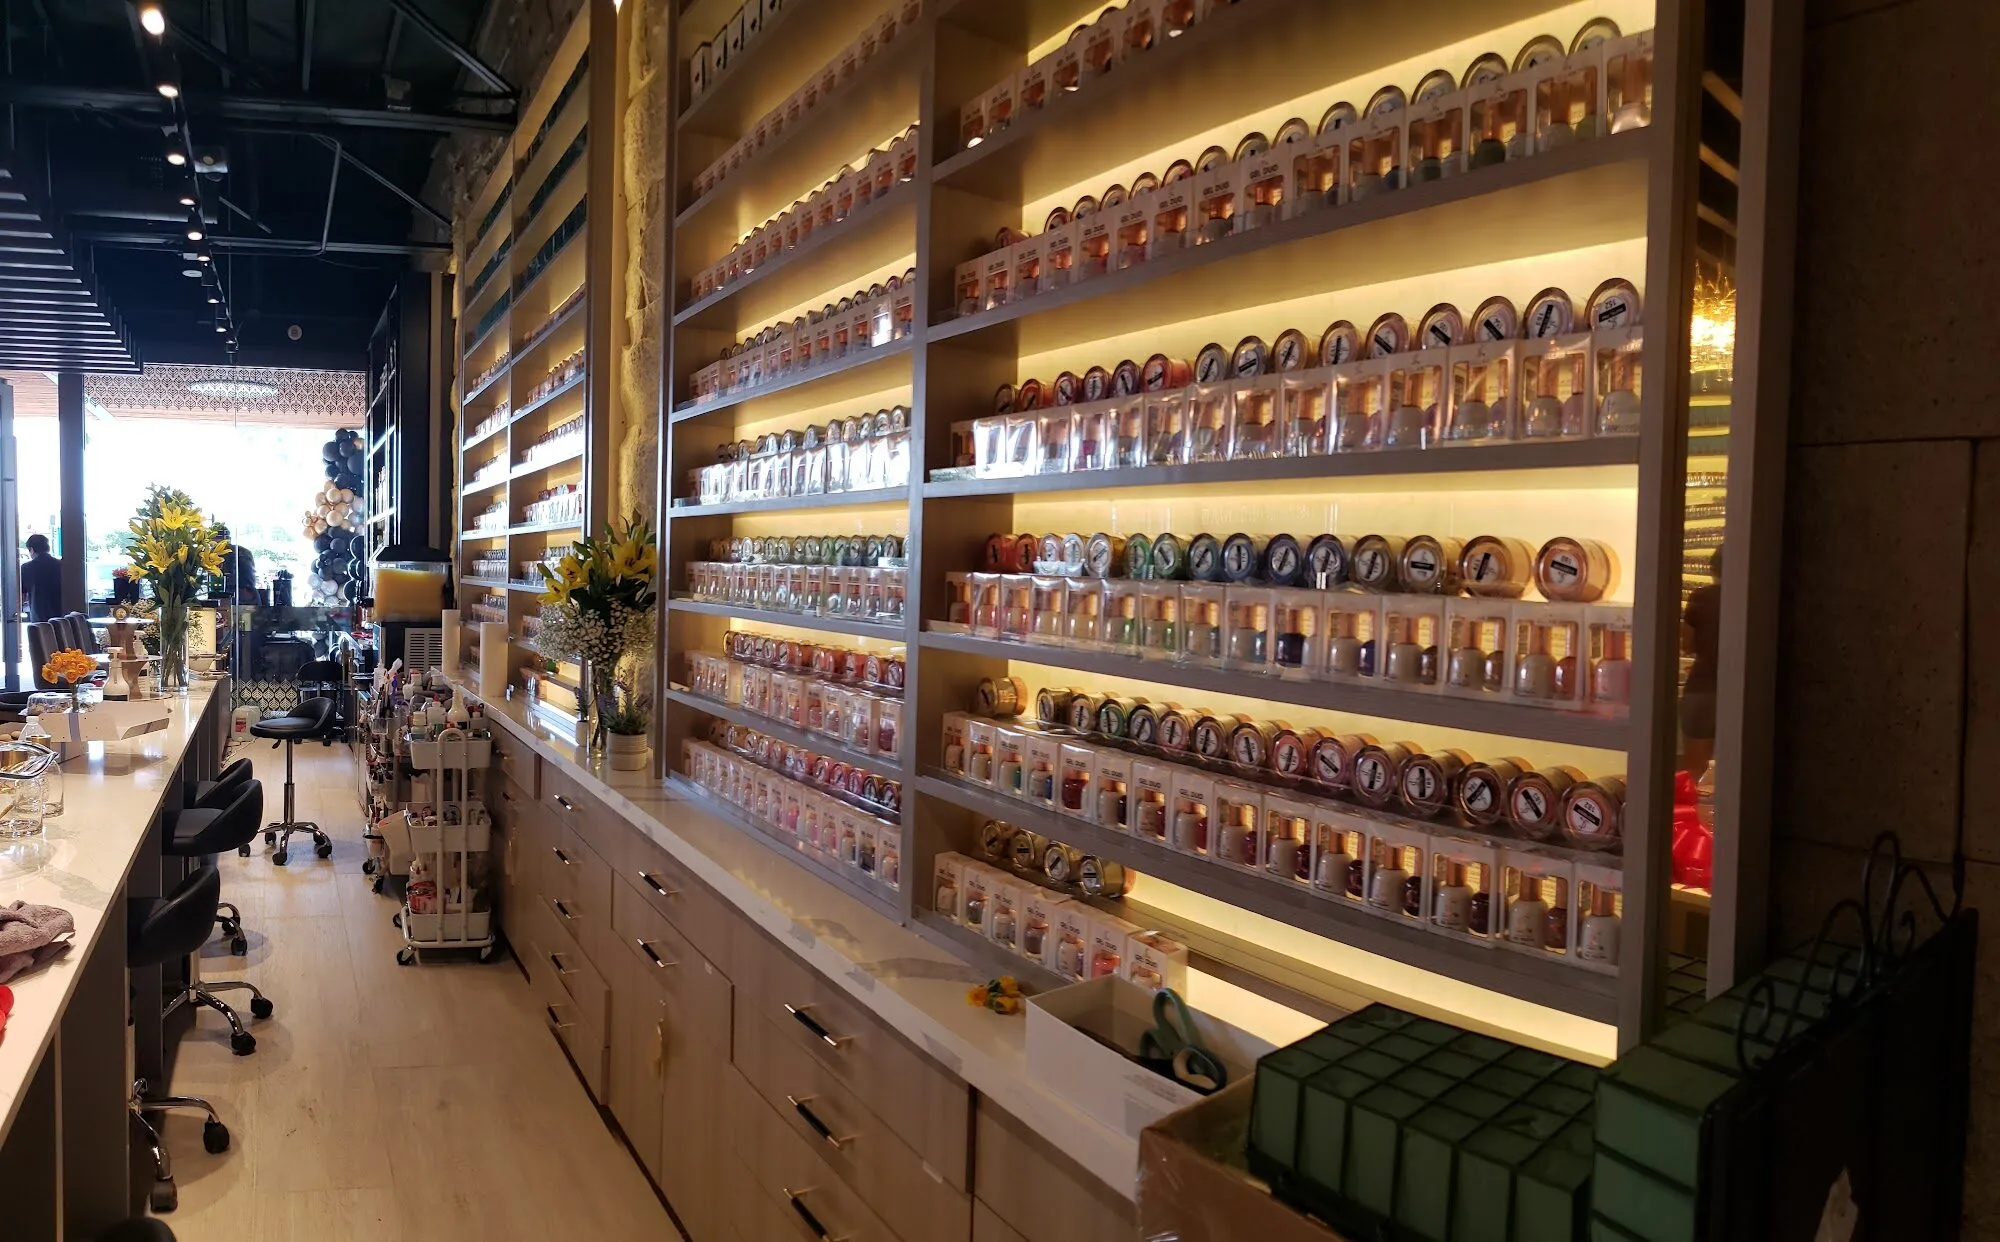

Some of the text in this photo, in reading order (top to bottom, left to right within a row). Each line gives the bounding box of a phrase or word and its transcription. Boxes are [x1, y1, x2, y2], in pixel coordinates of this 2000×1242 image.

[1263, 164, 1279, 175] DUO
[1214, 182, 1230, 192] DUO
[1170, 196, 1183, 205] DUO
[1604, 299, 1616, 309] 152
